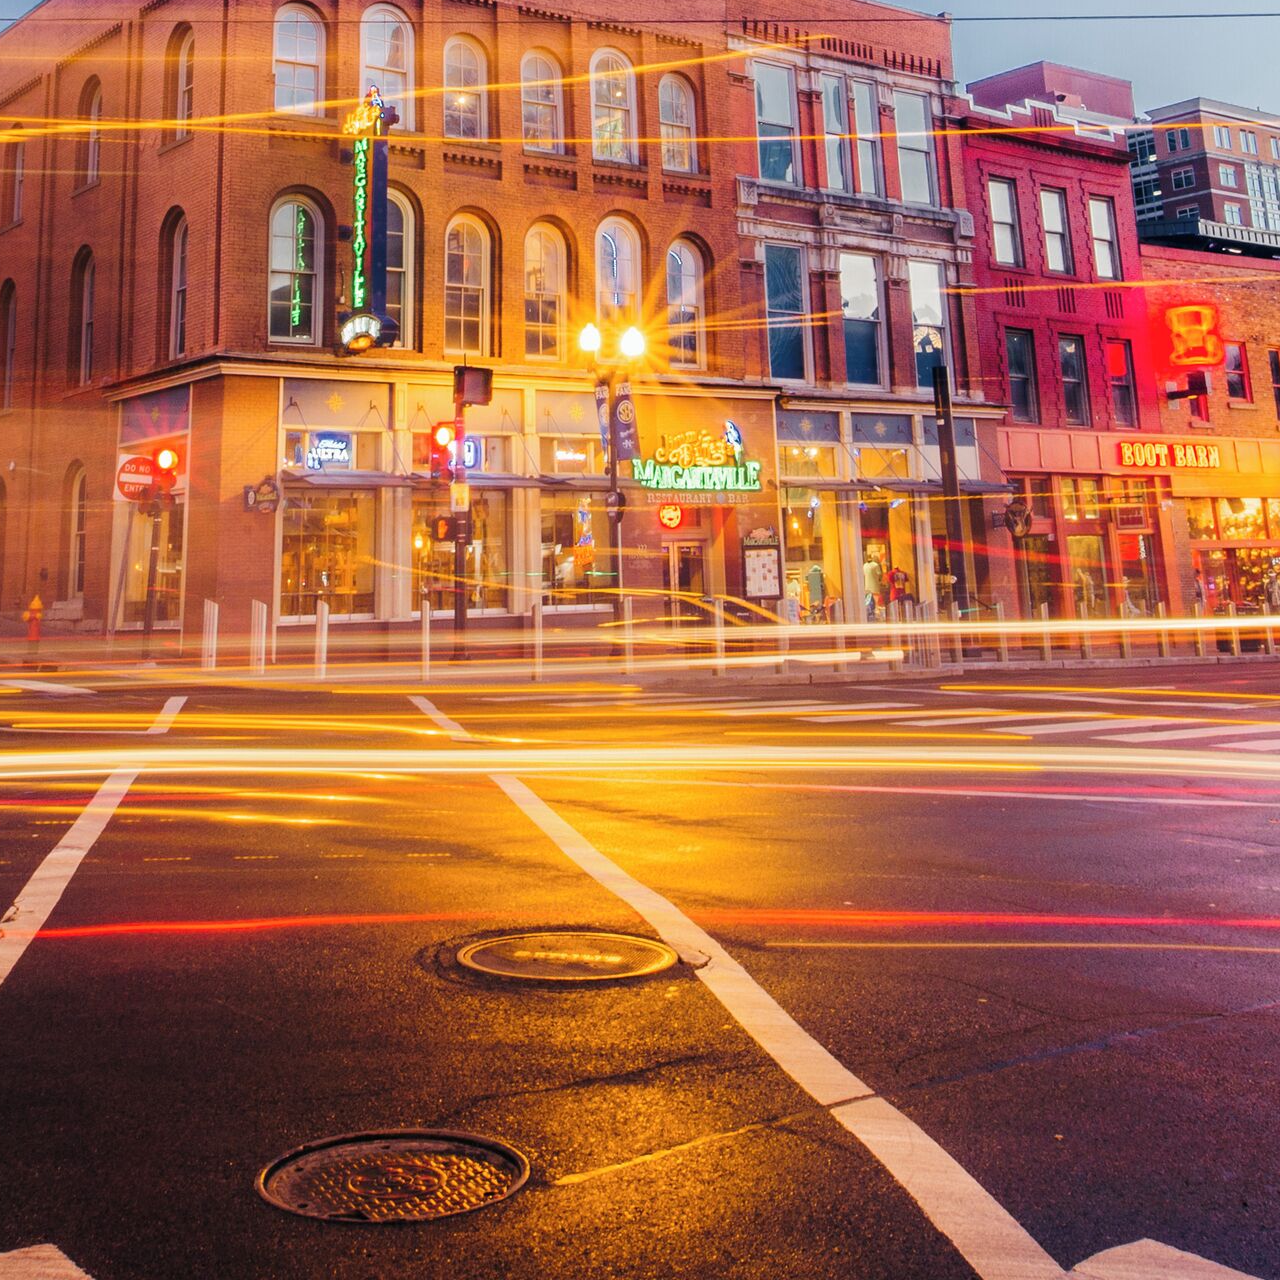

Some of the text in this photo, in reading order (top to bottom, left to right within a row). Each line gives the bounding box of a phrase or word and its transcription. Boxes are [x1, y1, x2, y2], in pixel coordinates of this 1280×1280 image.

[352, 136, 368, 308] MARGARITAVILLE
[1121, 443, 1220, 467] BOOT BARN
[125, 464, 151, 474] DO NO
[632, 459, 761, 490] MARGARITAVILLE
[647, 493, 750, 504] RESTAURANT BAR
